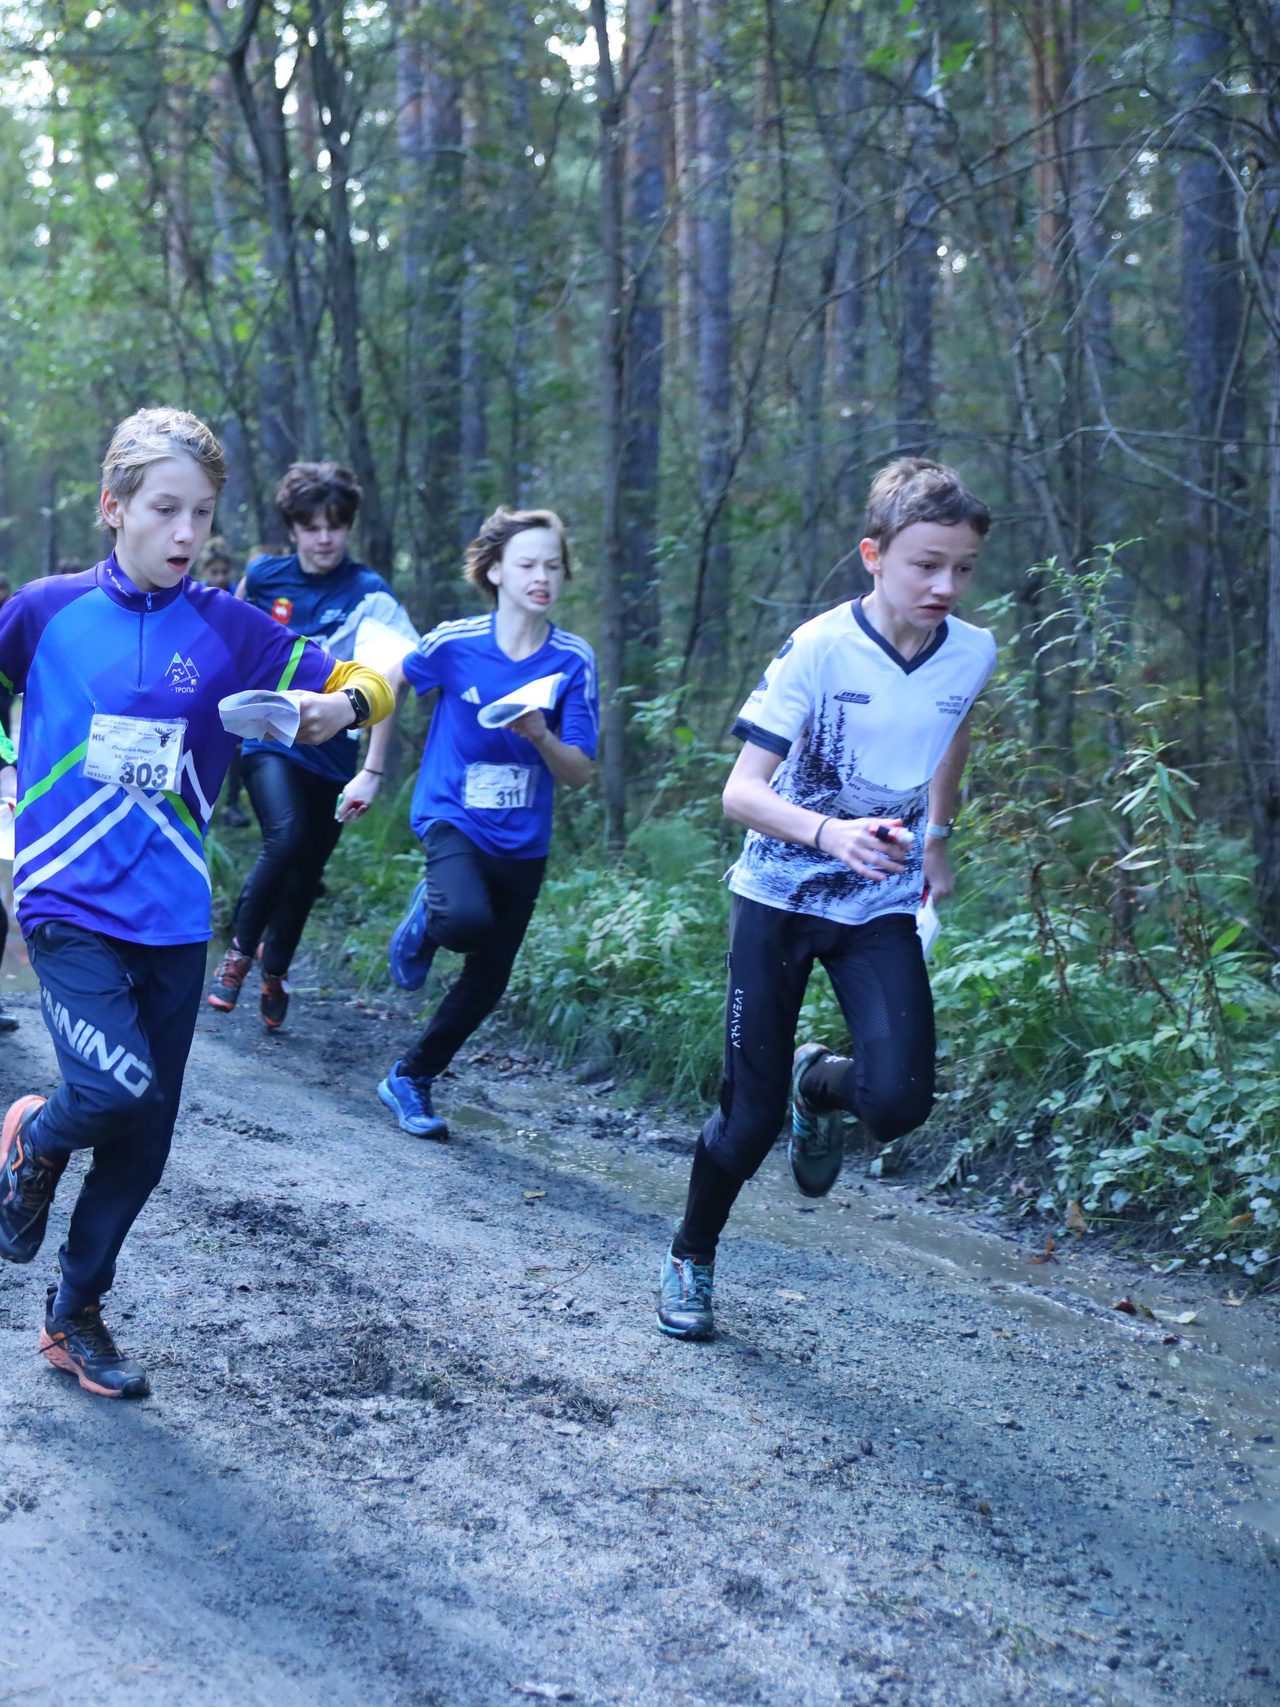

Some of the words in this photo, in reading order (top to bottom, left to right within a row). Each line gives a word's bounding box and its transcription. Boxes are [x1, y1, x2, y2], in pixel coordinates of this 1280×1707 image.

[119, 761, 168, 789] 303
[496, 791, 520, 806] 311
[867, 804, 904, 817] 30
